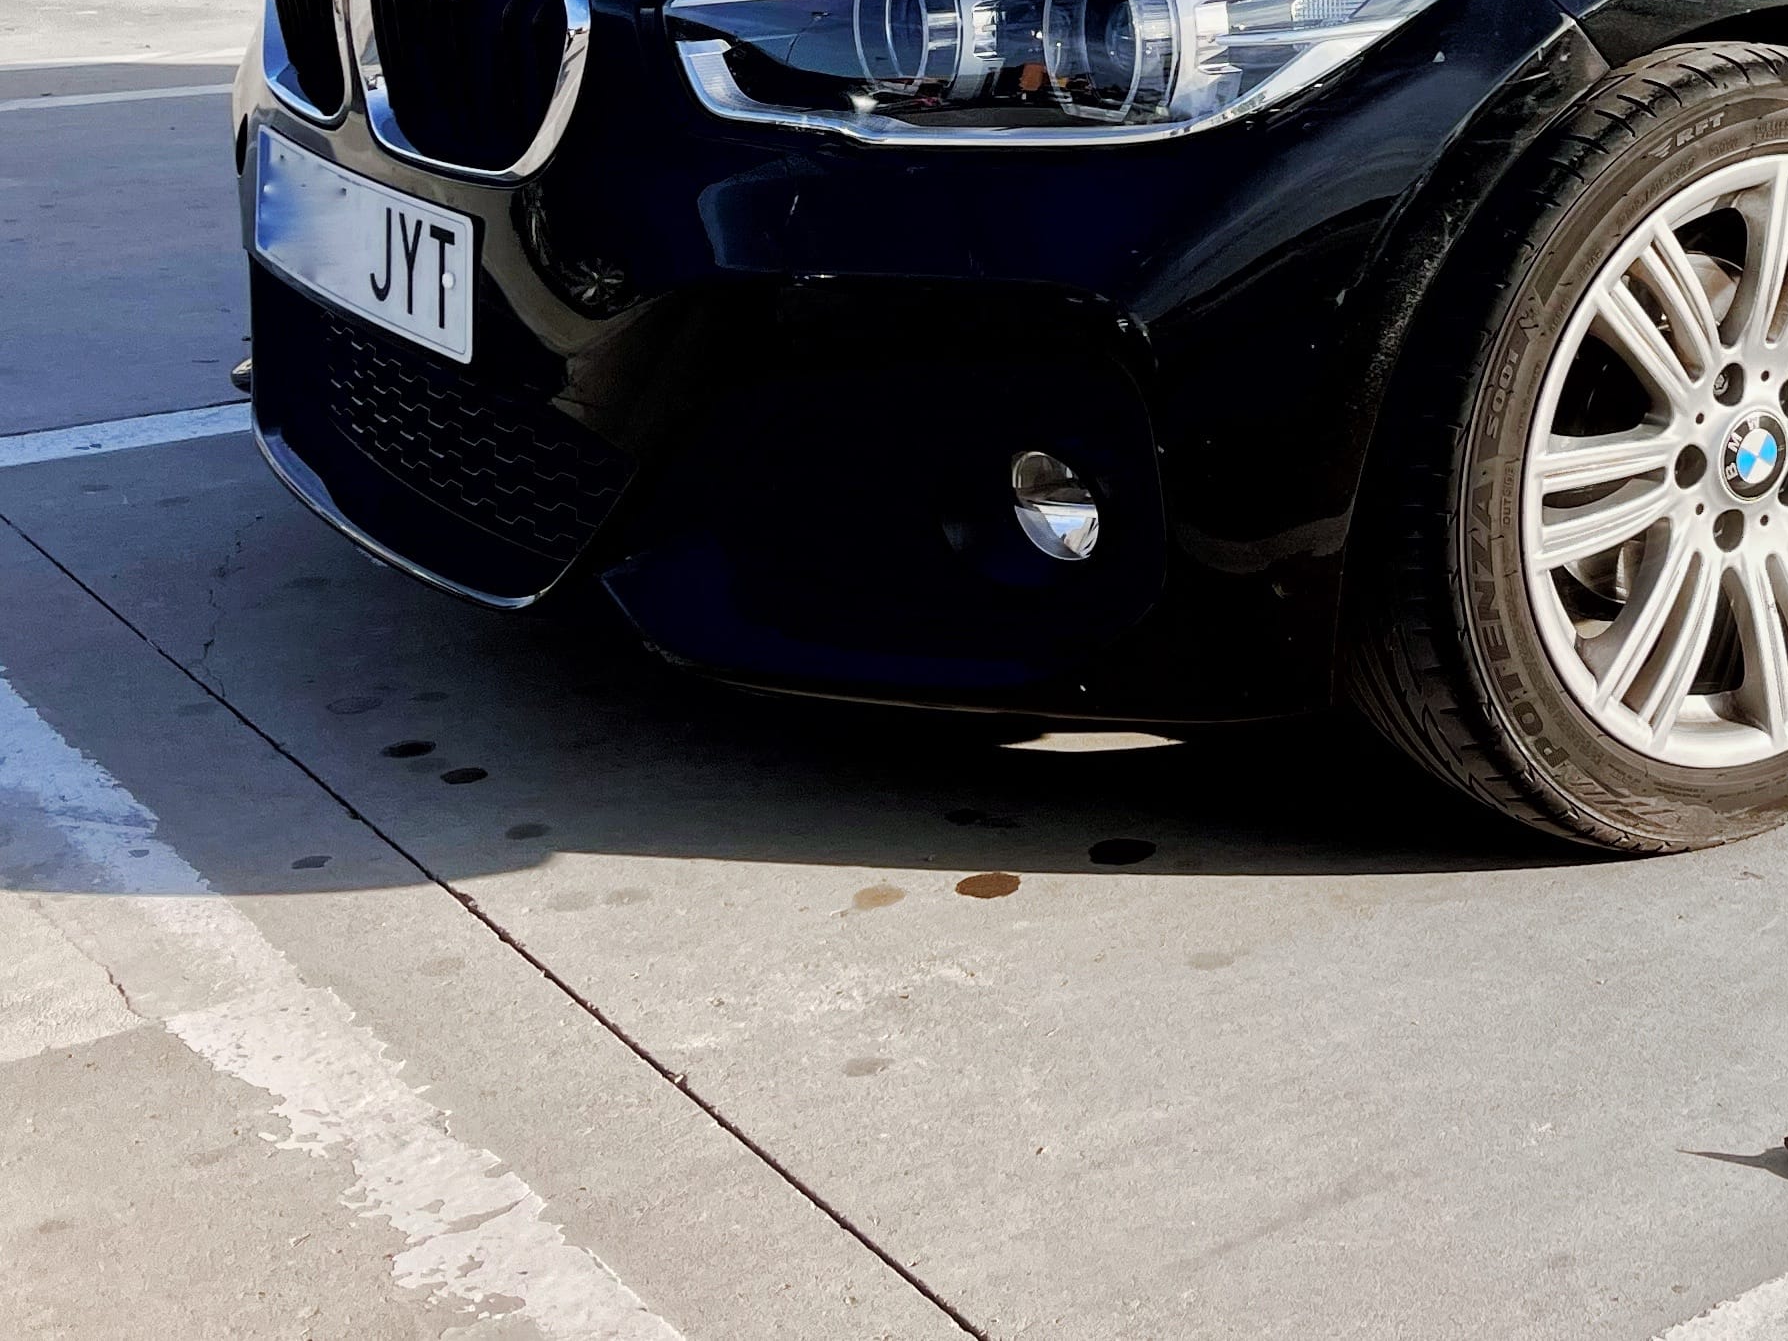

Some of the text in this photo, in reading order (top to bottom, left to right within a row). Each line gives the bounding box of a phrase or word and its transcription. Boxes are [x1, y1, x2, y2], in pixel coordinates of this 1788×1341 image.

[1676, 112, 1725, 147] RFT
[369, 207, 456, 330] JYT
[1724, 417, 1760, 480] BMW
[1470, 348, 1569, 768] POTENZA S001
